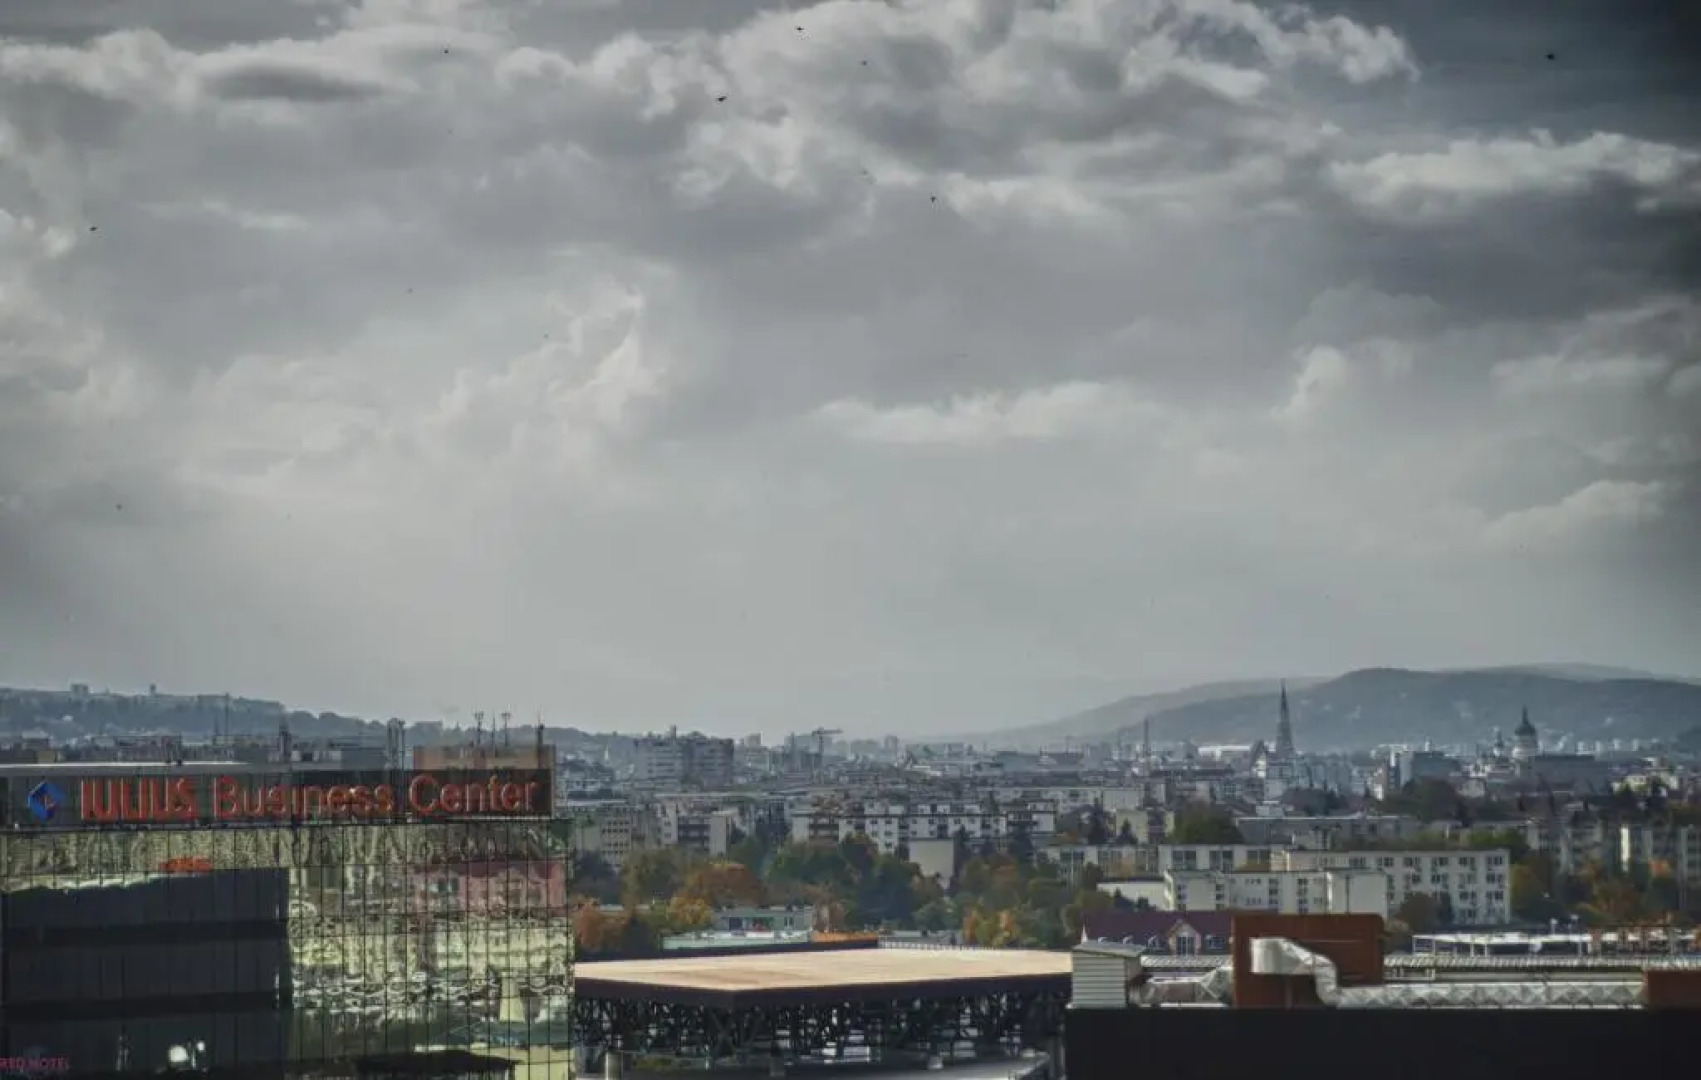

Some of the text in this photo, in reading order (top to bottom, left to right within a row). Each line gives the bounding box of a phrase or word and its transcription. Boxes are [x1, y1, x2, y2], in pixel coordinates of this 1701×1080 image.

[80, 772, 538, 821] IULIUS Business Center
